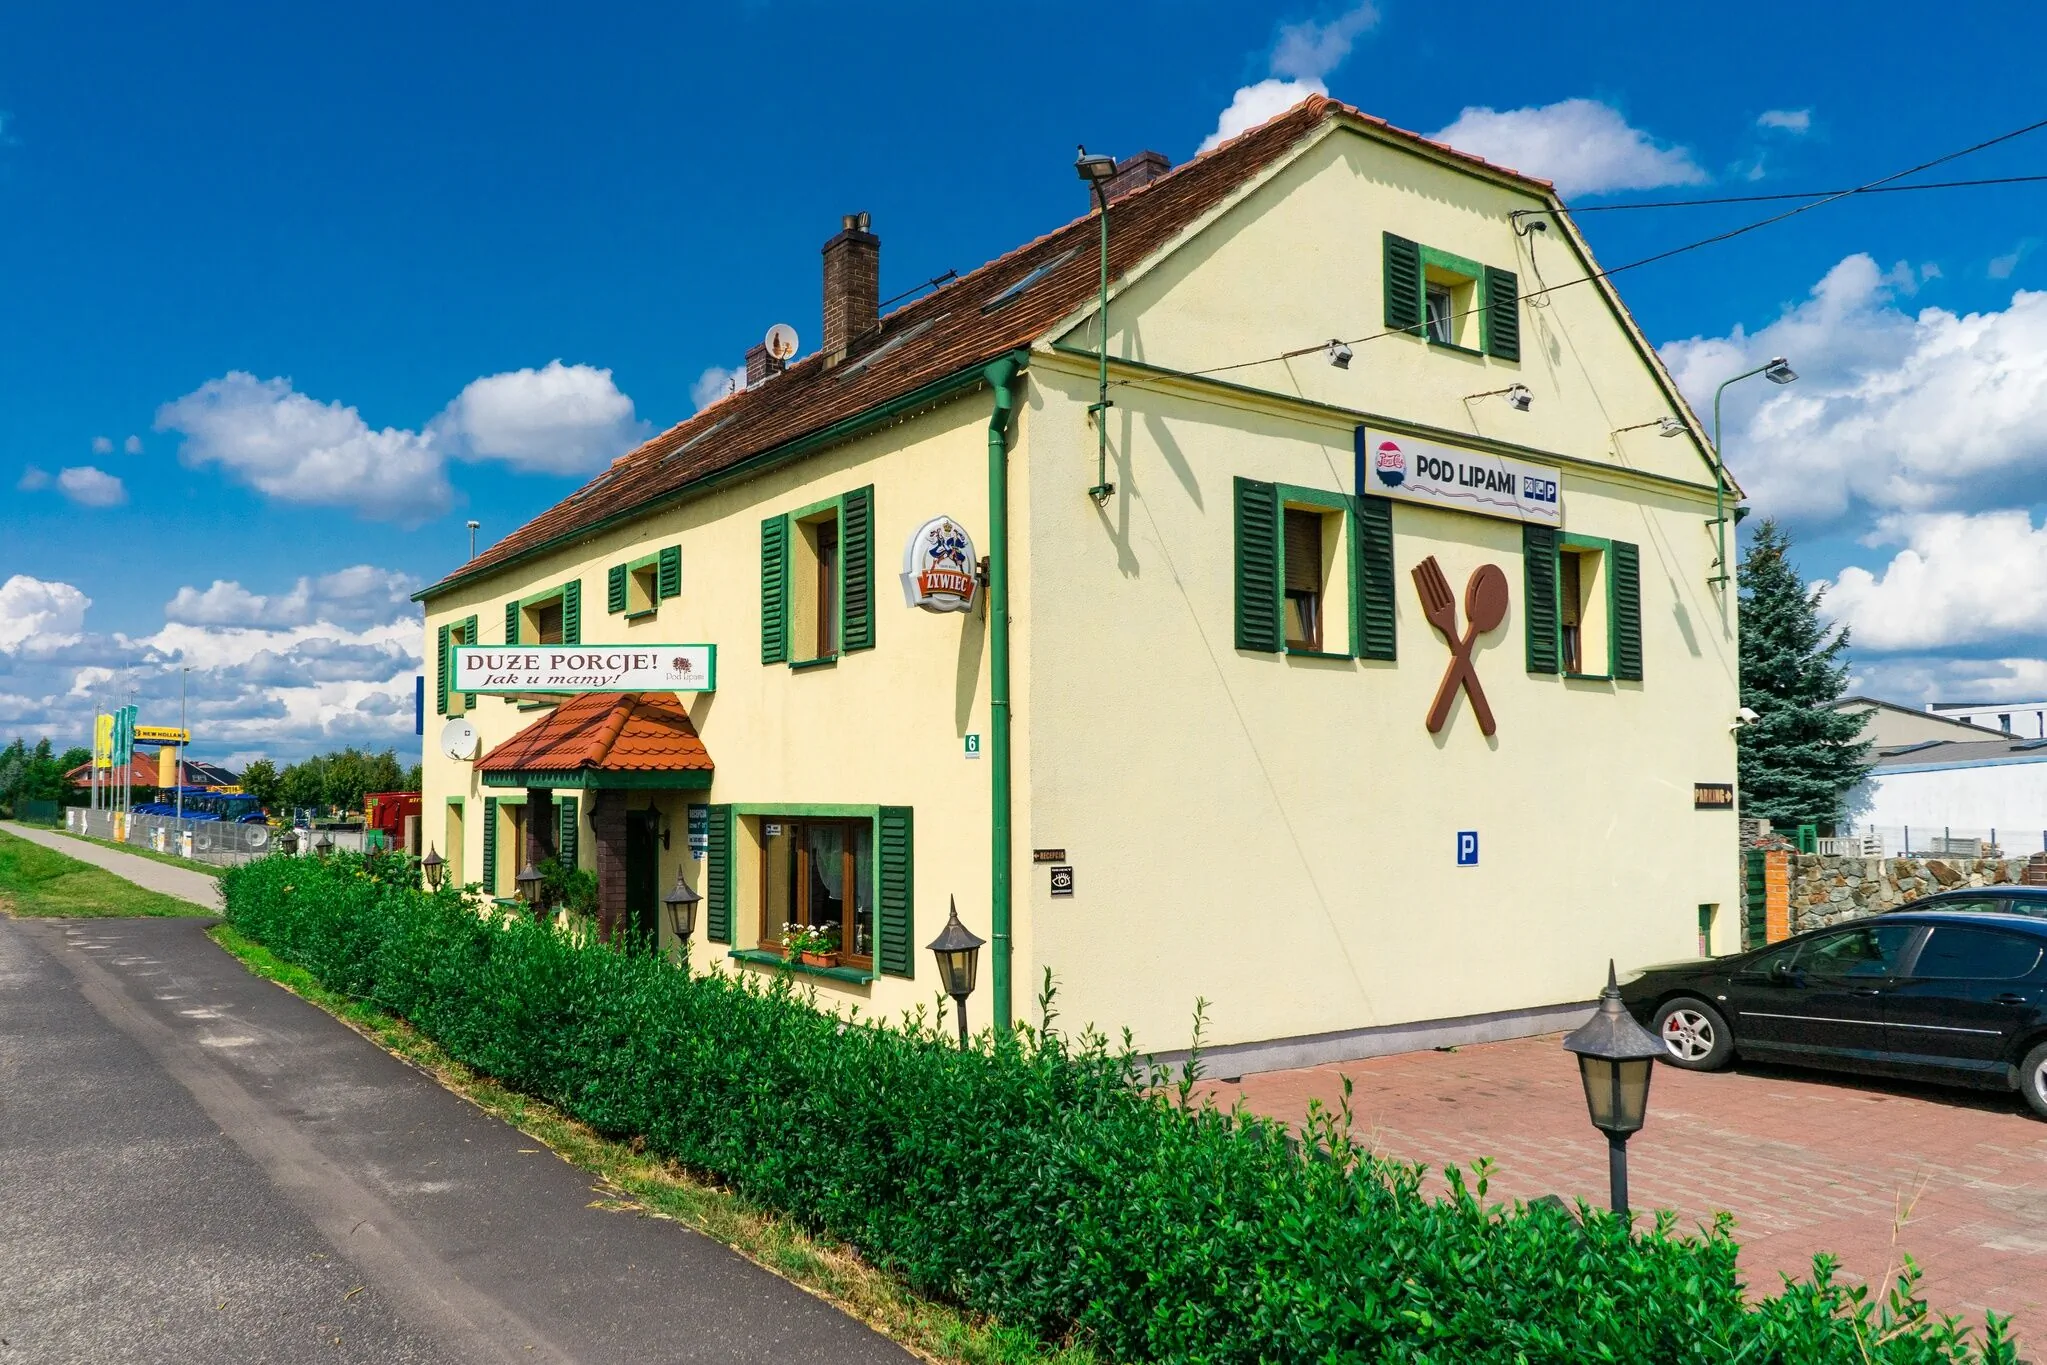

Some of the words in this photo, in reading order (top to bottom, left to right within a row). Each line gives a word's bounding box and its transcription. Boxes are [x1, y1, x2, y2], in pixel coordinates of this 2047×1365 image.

[1416, 455, 1454, 483] POD
[1459, 464, 1516, 495] LIPAMI
[1546, 485, 1555, 499] P
[926, 572, 968, 592] ŻYWIEC
[550, 654, 658, 673] PORCJE!
[526, 676, 540, 684] u
[547, 674, 621, 687] mamy!
[666, 672, 682, 681] Pod
[968, 735, 976, 751] 6
[1695, 788, 1725, 803] PARKING
[1461, 835, 1474, 861] P
